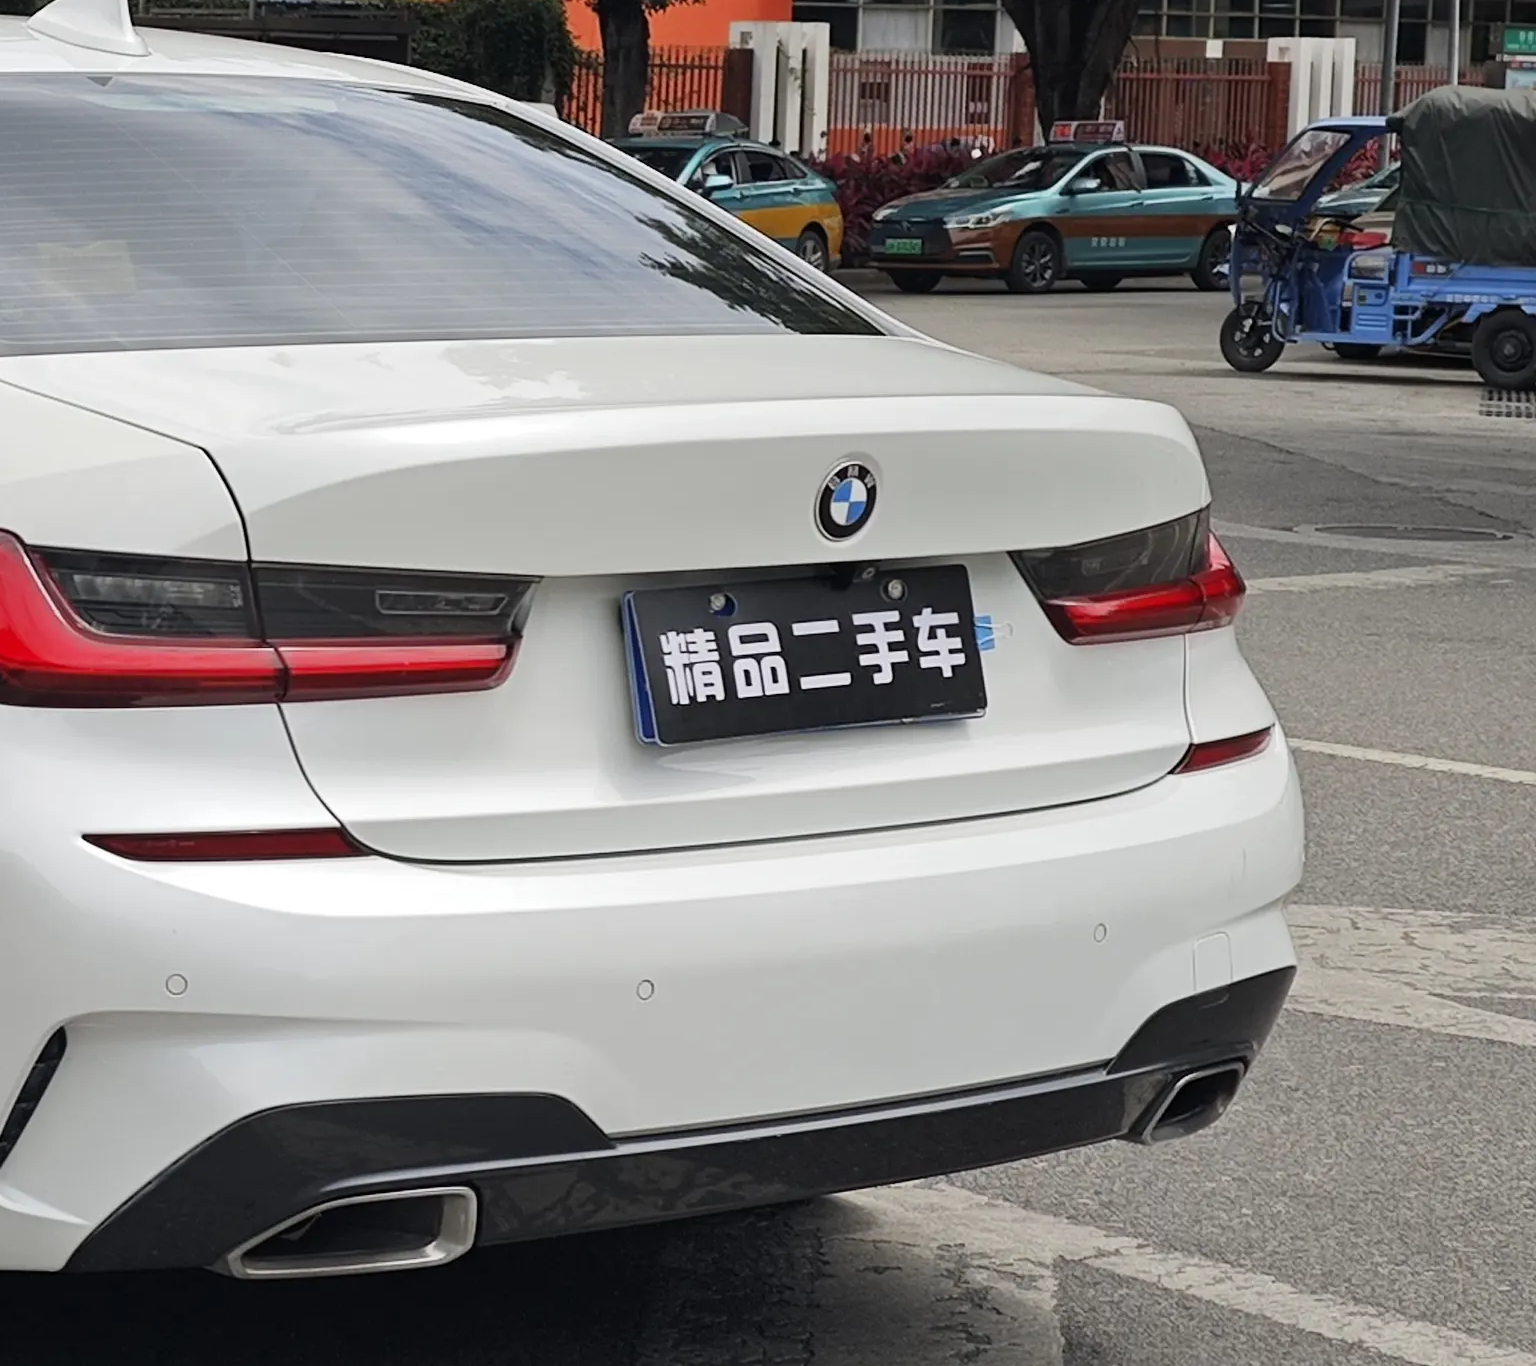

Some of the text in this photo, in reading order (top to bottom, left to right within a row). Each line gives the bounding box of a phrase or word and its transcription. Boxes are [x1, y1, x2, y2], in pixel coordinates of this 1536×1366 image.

[827, 465, 876, 490] BMW
[659, 607, 966, 705] 精品二手车
